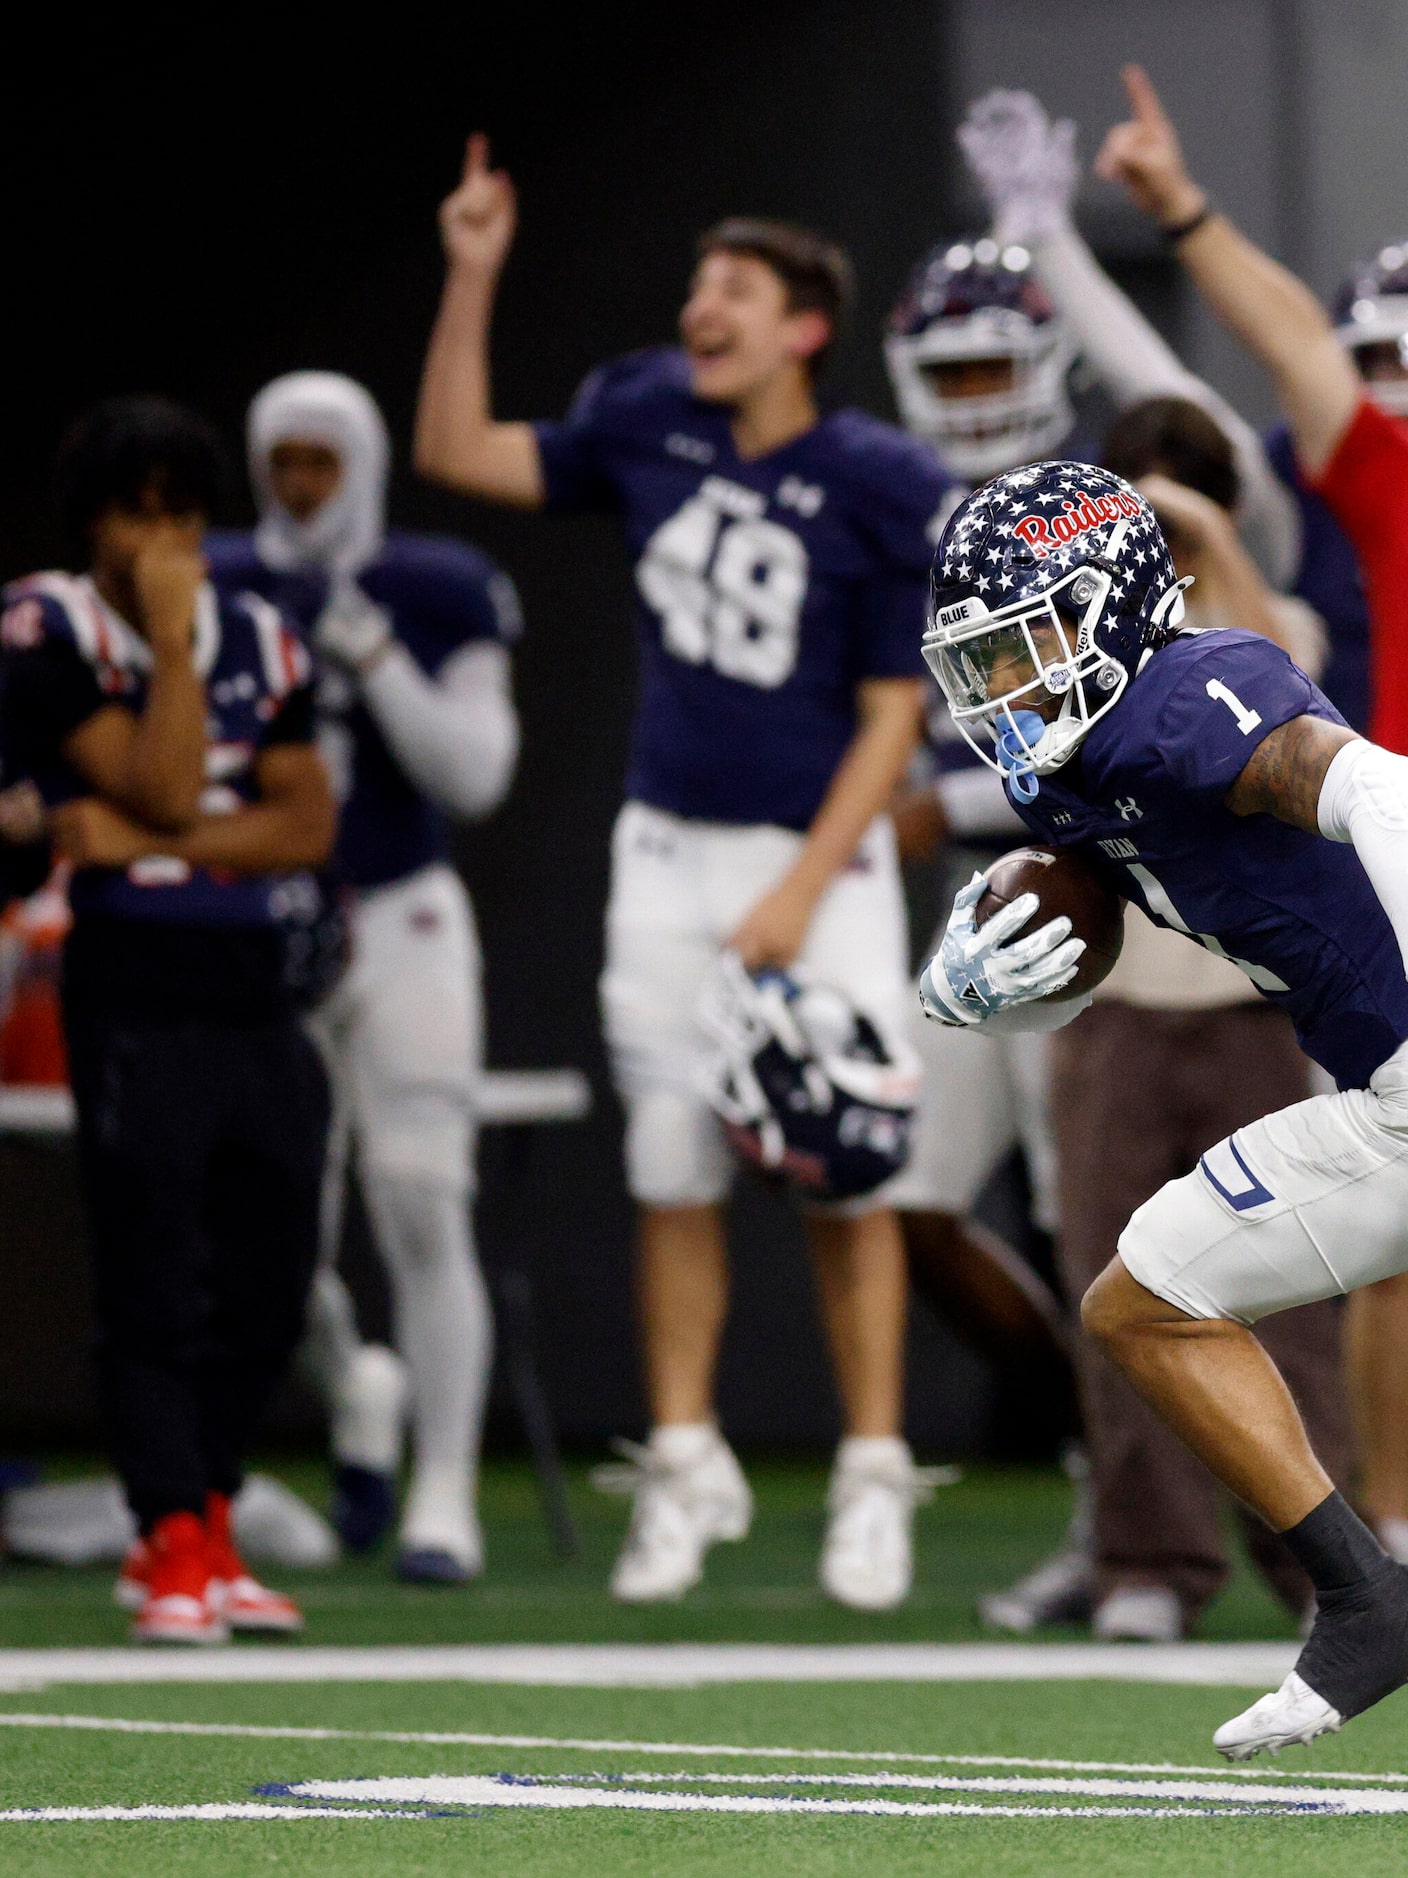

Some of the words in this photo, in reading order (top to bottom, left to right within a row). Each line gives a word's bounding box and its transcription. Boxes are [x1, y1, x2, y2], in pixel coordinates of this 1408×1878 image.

[1012, 491, 1141, 559] Raiders
[635, 497, 809, 690] 48
[941, 605, 970, 626] BLUE
[1205, 678, 1262, 736] 1
[1096, 837, 1140, 859] RYAN
